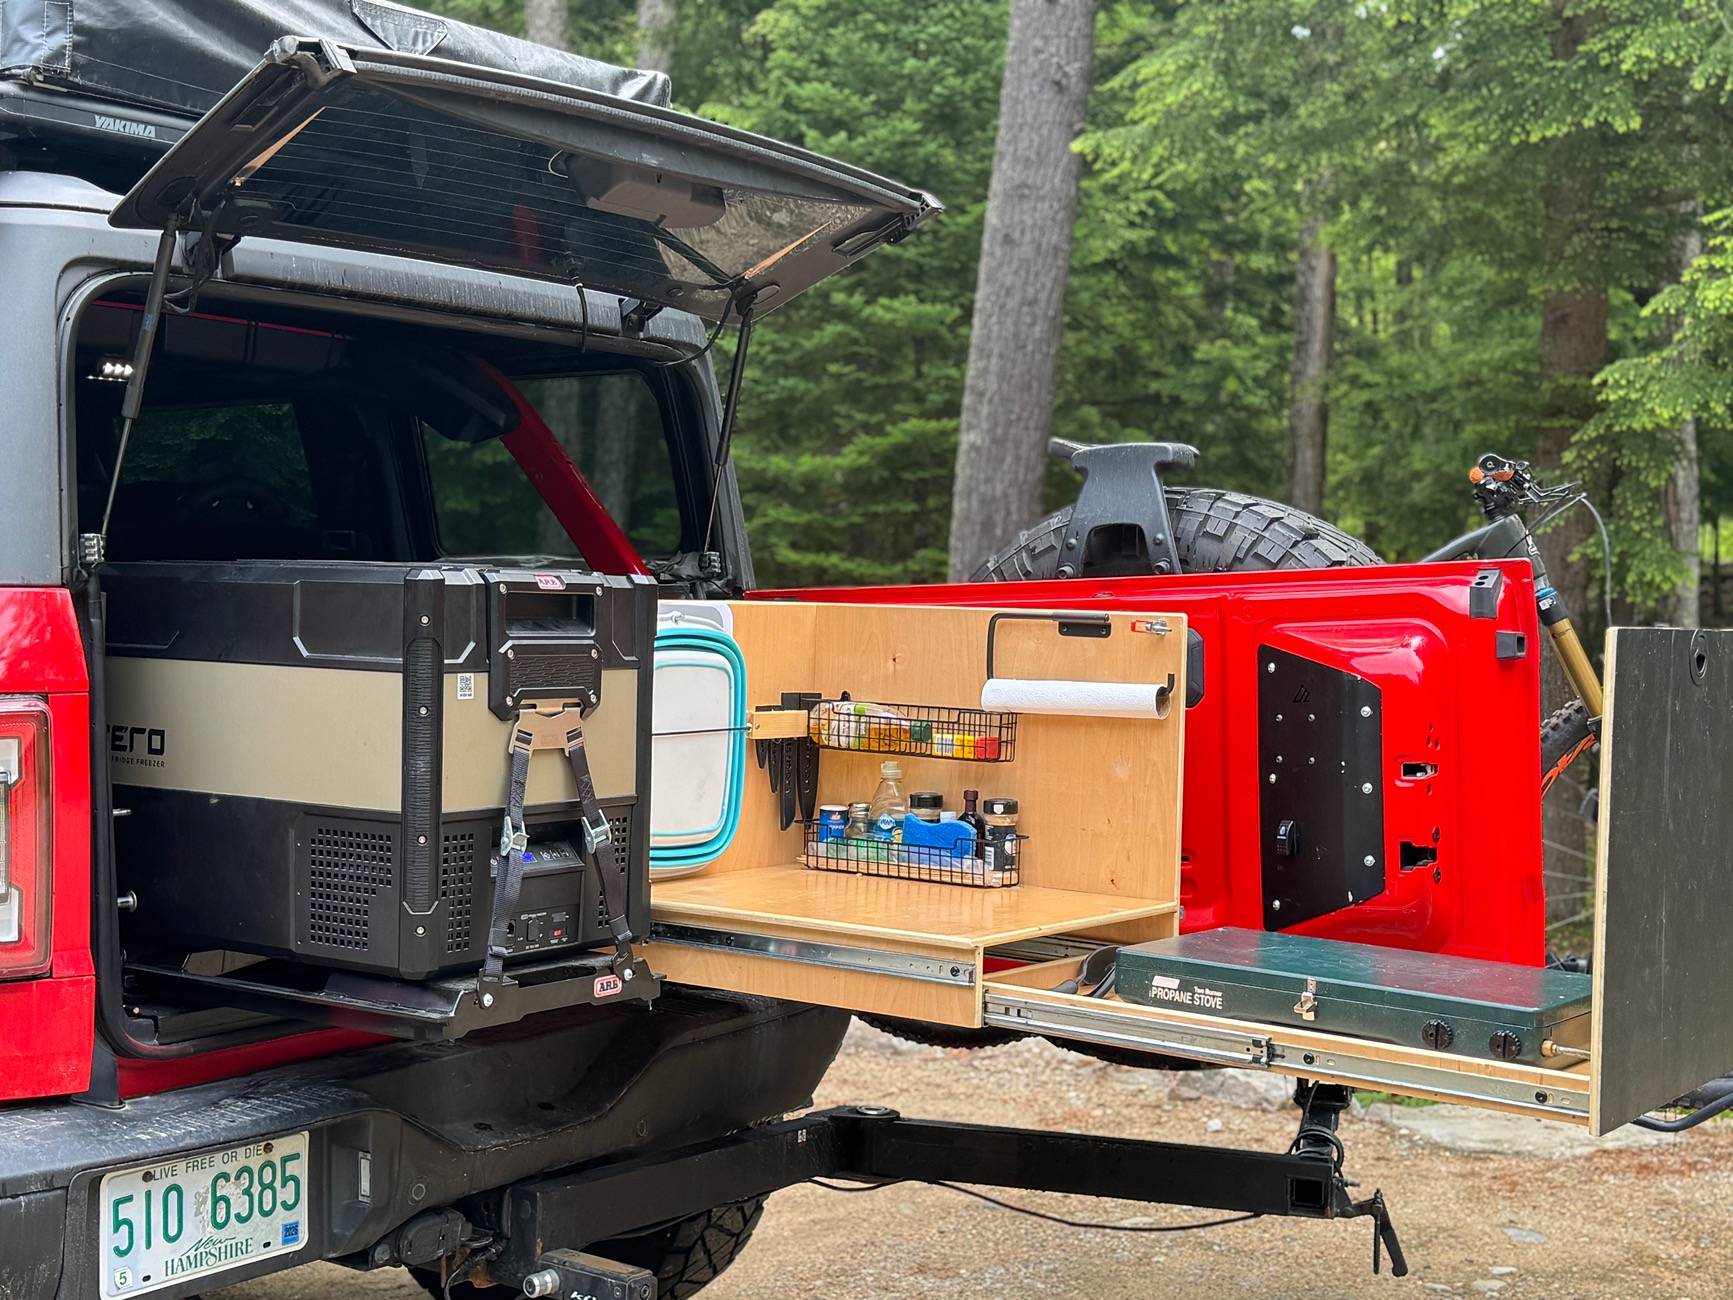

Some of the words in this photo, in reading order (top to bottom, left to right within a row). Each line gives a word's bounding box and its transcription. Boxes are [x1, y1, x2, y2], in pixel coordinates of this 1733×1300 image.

[95, 114, 156, 138] YAKIMA
[599, 979, 619, 992] ARB
[1151, 986, 1192, 1004] PROPANE
[1193, 993, 1222, 1009] STOVE
[154, 1165, 178, 1181] LIVE
[185, 1158, 215, 1176] FREE
[222, 1149, 238, 1164] OR
[244, 1143, 264, 1160] DIE
[112, 1183, 184, 1258] 510
[210, 1152, 301, 1231] 6385
[164, 1237, 254, 1277] HAMPSHIRE
[181, 1236, 237, 1257] New
[119, 1271, 128, 1286] 5
